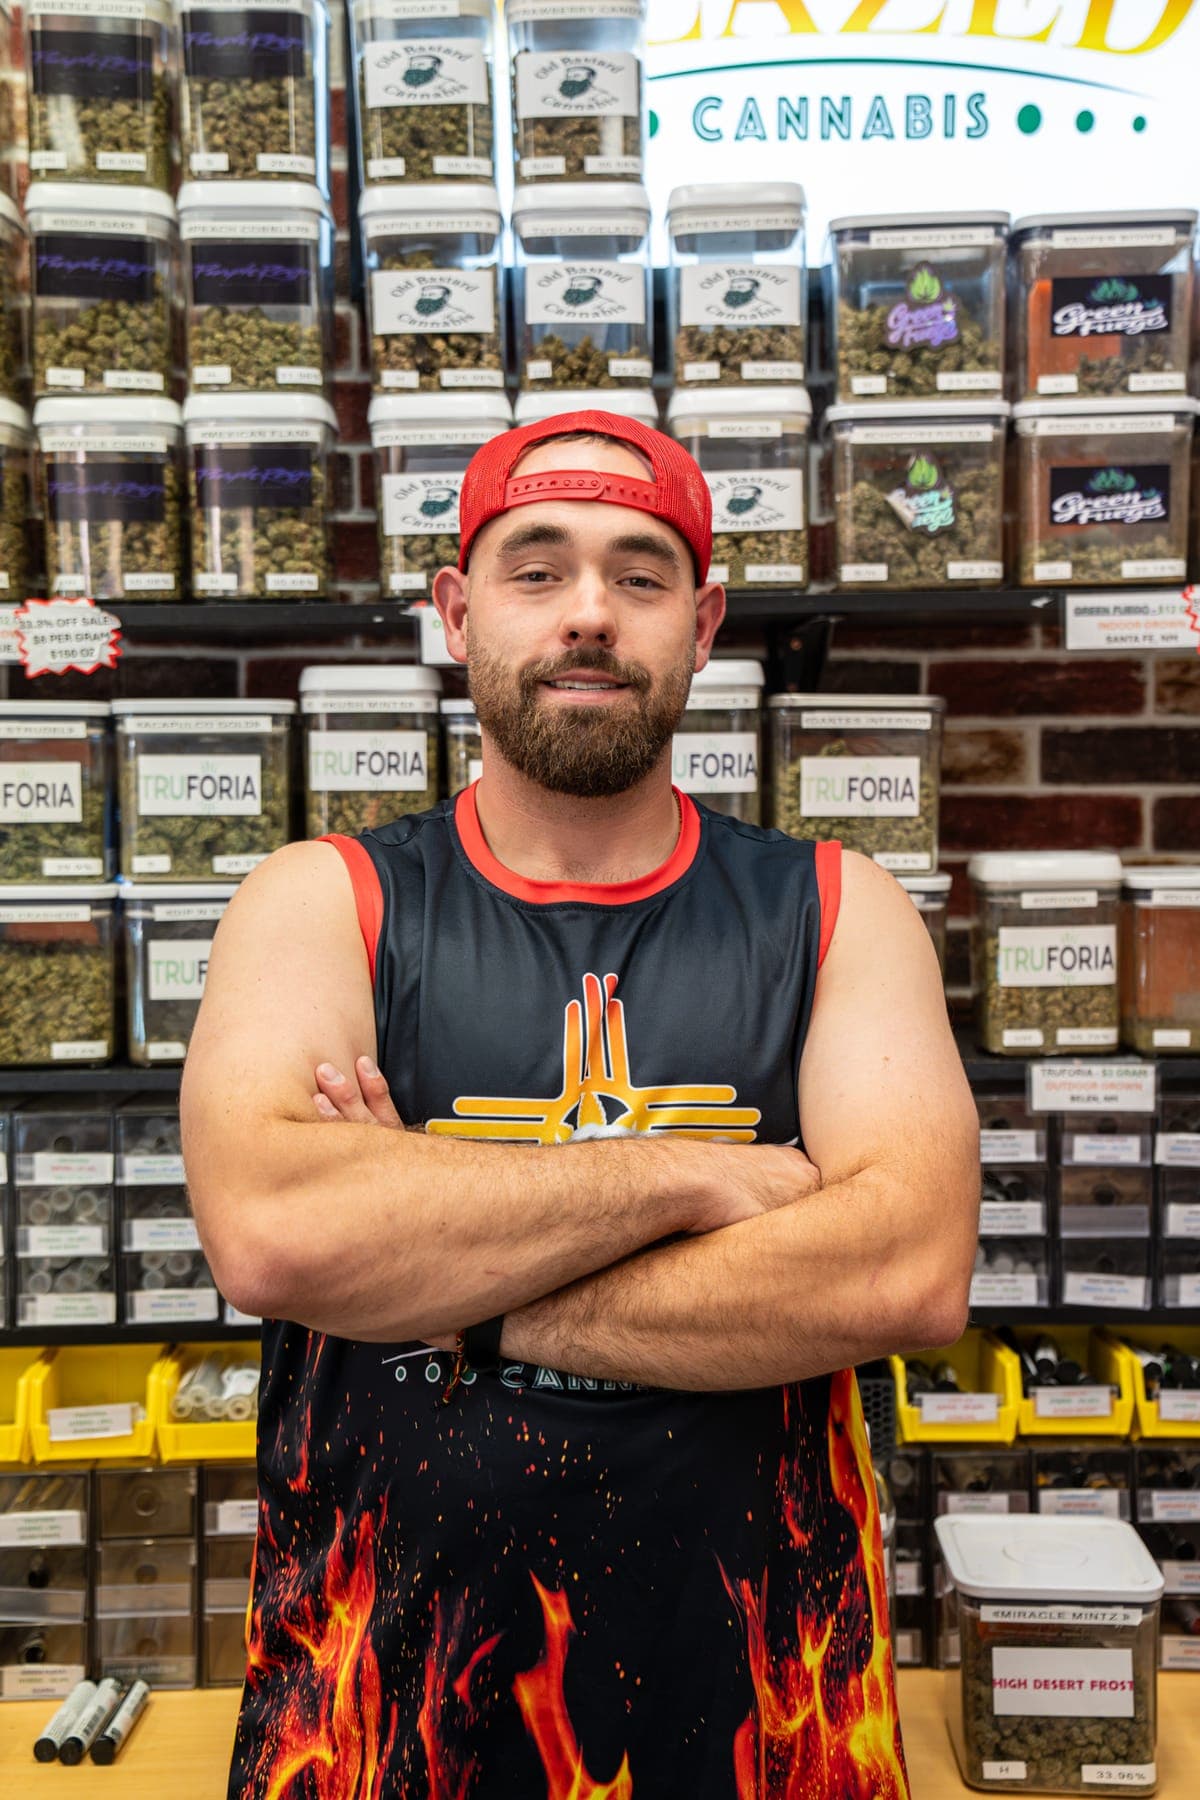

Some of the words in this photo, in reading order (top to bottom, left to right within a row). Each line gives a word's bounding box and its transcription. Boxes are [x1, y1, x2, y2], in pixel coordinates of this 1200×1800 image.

[375, 51, 402, 70] Old
[534, 61, 559, 80] Old
[693, 92, 990, 142] CANNABIS
[390, 281, 414, 298] Old
[537, 271, 562, 289] Old
[700, 273, 724, 290] Old
[1053, 301, 1144, 330] Green
[1078, 314, 1168, 337] Fuego
[1052, 490, 1142, 519] Green
[1076, 504, 1166, 526] Fuego
[311, 750, 424, 777] TRUFORIA
[674, 753, 758, 779] UFORIA
[142, 774, 258, 801] TRUFORIA
[802, 776, 916, 803] TRUFORIA
[152, 958, 208, 985] TRUF
[1002, 945, 1114, 973] TRUFORIA
[992, 1678, 1028, 1690] HIGH
[1033, 1679, 1084, 1691] DESERT
[1089, 1679, 1135, 1692] FROST
